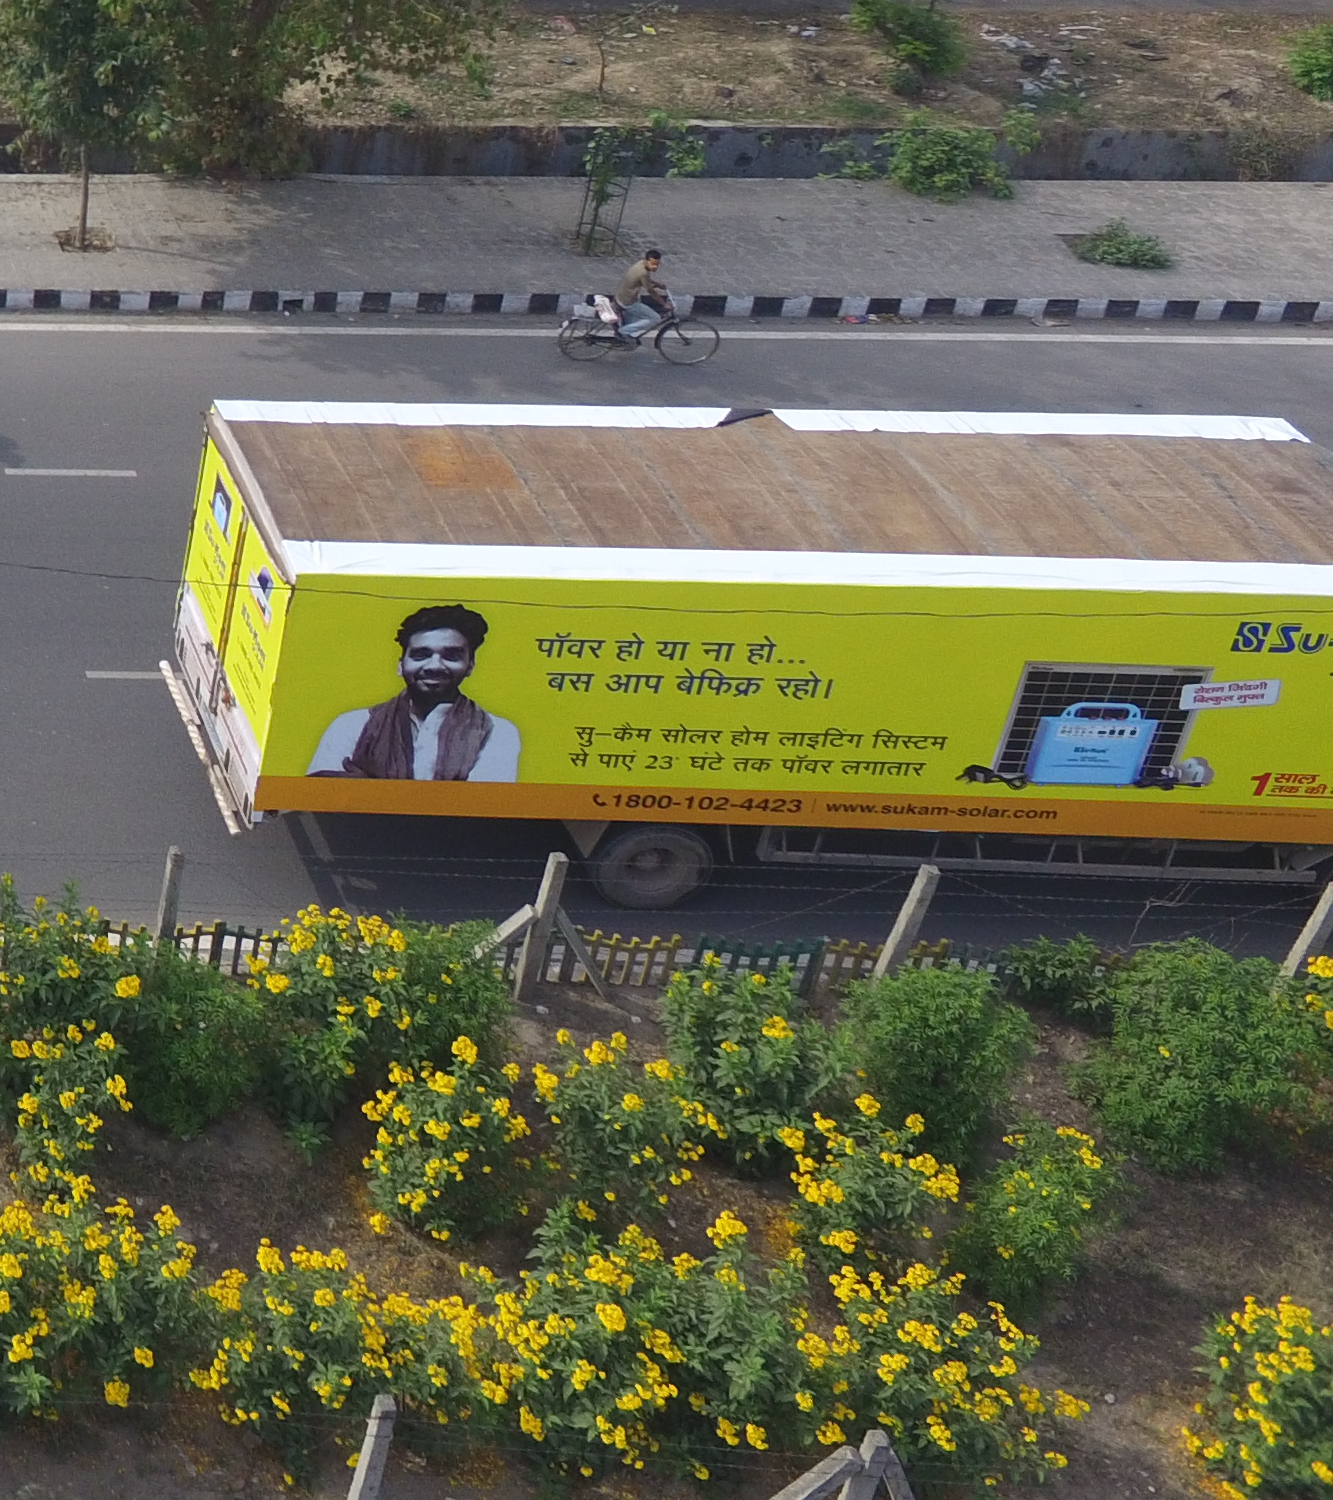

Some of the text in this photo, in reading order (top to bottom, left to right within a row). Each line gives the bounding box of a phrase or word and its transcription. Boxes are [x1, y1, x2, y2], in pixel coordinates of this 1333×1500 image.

[535, 632, 606, 659] पॉवर
[615, 632, 645, 662] हो
[656, 640, 690, 661] या
[701, 641, 735, 663] ना
[546, 671, 594, 692] बस
[605, 672, 664, 695] आप
[675, 668, 764, 698] बेफिक्र
[660, 724, 722, 745] सोलर
[731, 725, 769, 747] होम
[779, 727, 864, 751] लाइटिंग
[871, 728, 948, 751] सिस्टम
[568, 748, 589, 769] से
[688, 751, 725, 772] घंटे
[733, 756, 773, 773] तक
[781, 754, 834, 775] पॉवर
[841, 760, 926, 777] लगातार
[1274, 772, 1320, 785] साल
[612, 794, 802, 814] 1800-102-4423
[826, 803, 1058, 820] www.sukam-solar.com
